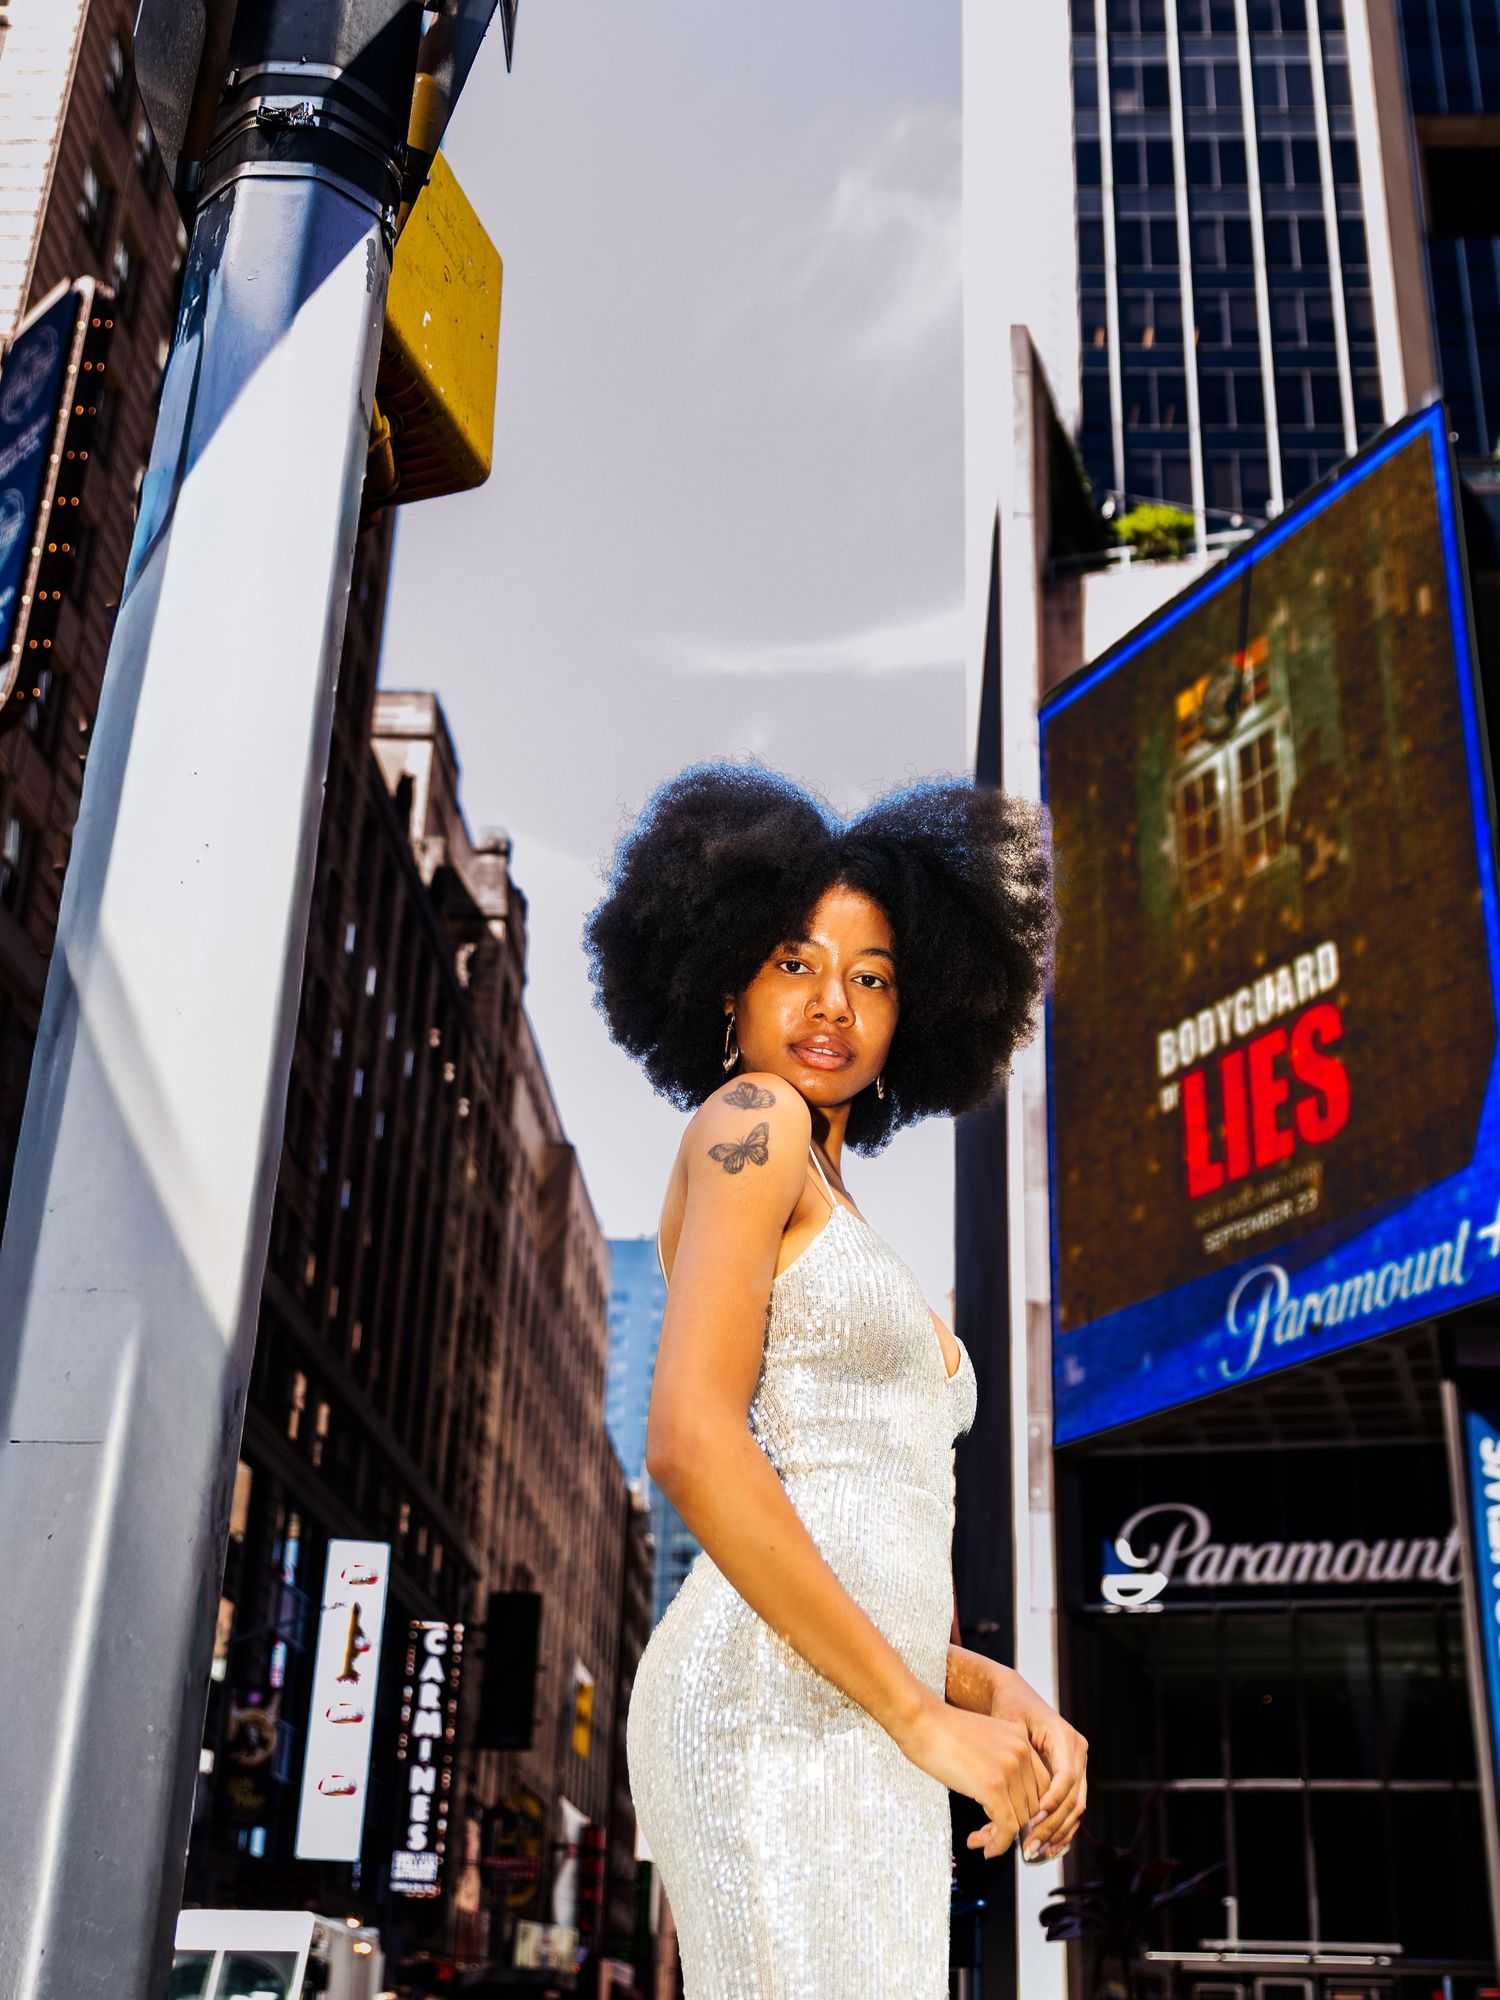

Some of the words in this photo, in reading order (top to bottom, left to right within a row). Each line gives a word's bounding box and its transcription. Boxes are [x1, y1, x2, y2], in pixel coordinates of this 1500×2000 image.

[1157, 941, 1340, 1077] BODYGUARD
[1182, 1003, 1351, 1199] LIES
[1203, 1199, 1295, 1254] SEPTEMBER
[1101, 1502, 1463, 1606] Paramount
